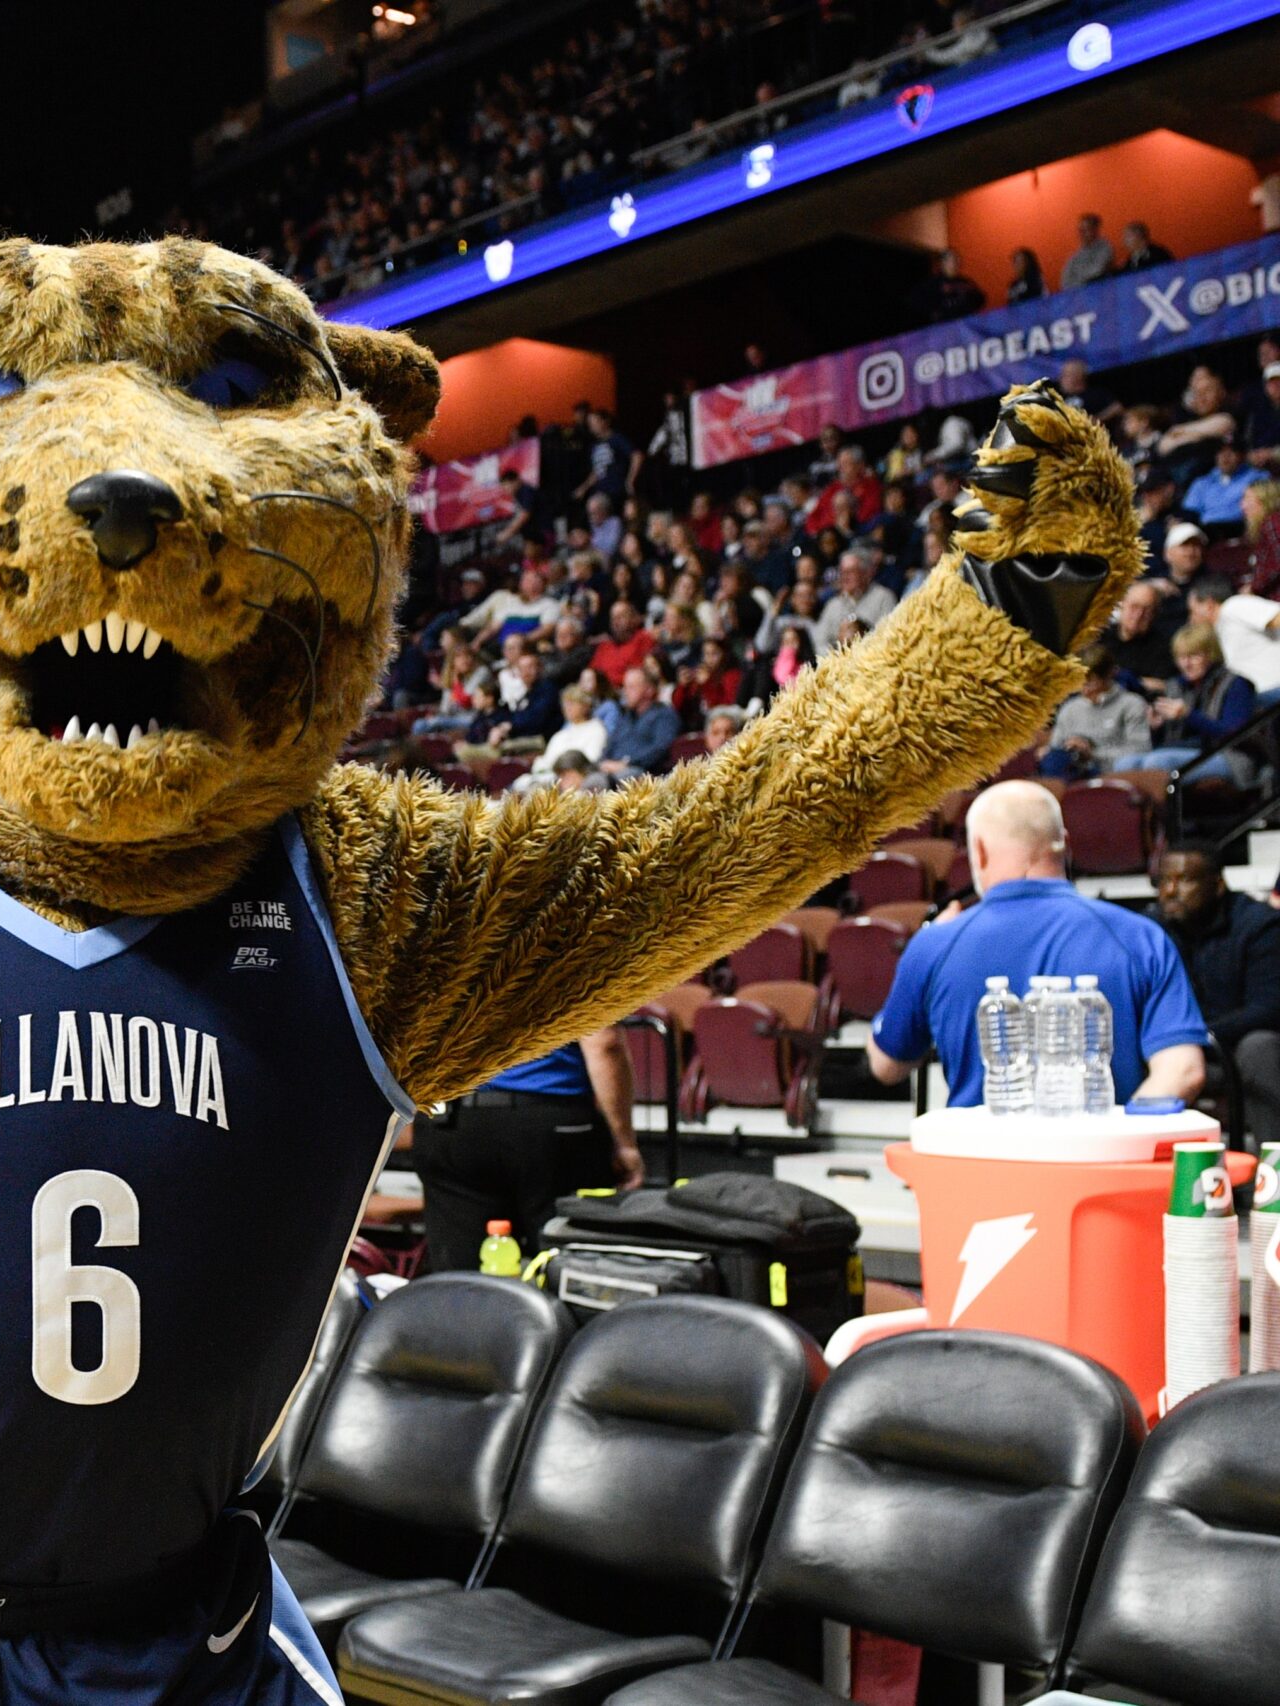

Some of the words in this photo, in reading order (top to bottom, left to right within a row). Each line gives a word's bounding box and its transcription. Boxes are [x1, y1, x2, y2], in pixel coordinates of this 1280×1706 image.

[914, 312, 1097, 385] @BIGEAST
[232, 901, 253, 914] BE
[258, 900, 287, 915] THE
[229, 914, 292, 930] CHANGE
[237, 946, 268, 957] BIG
[233, 956, 278, 967] EAST
[31, 1168, 140, 1405] 6
